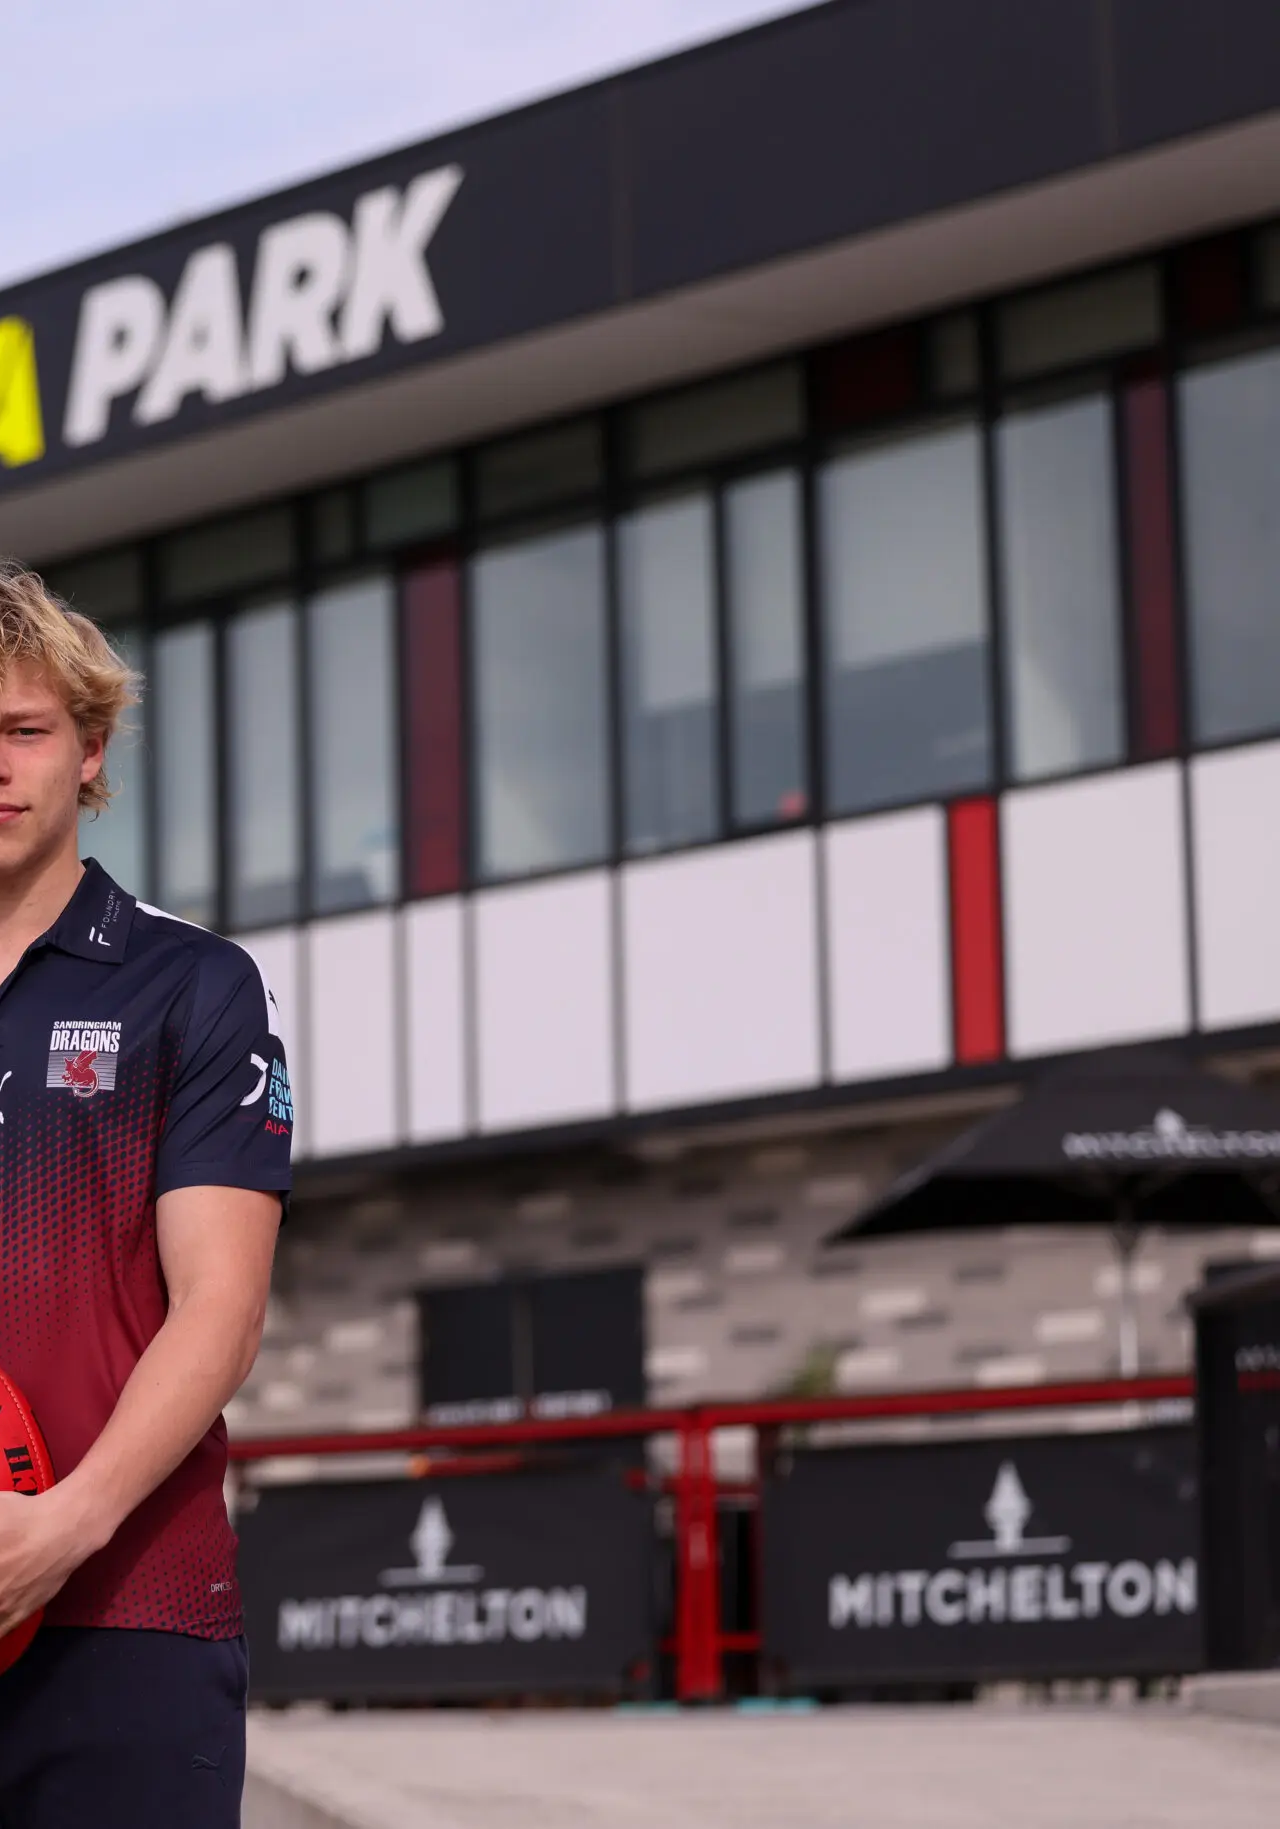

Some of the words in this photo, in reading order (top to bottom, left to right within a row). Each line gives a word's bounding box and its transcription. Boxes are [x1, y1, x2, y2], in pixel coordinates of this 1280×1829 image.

[62, 163, 465, 448] PARK
[101, 889, 116, 929] FOUNDRY
[49, 1029, 121, 1053] DRAGONS
[53, 1020, 122, 1031] SANDRINGHAM
[268, 1096, 294, 1122] CENT
[828, 1557, 1198, 1628] MITCHELTON
[277, 1586, 587, 1651] MITCHELTON
